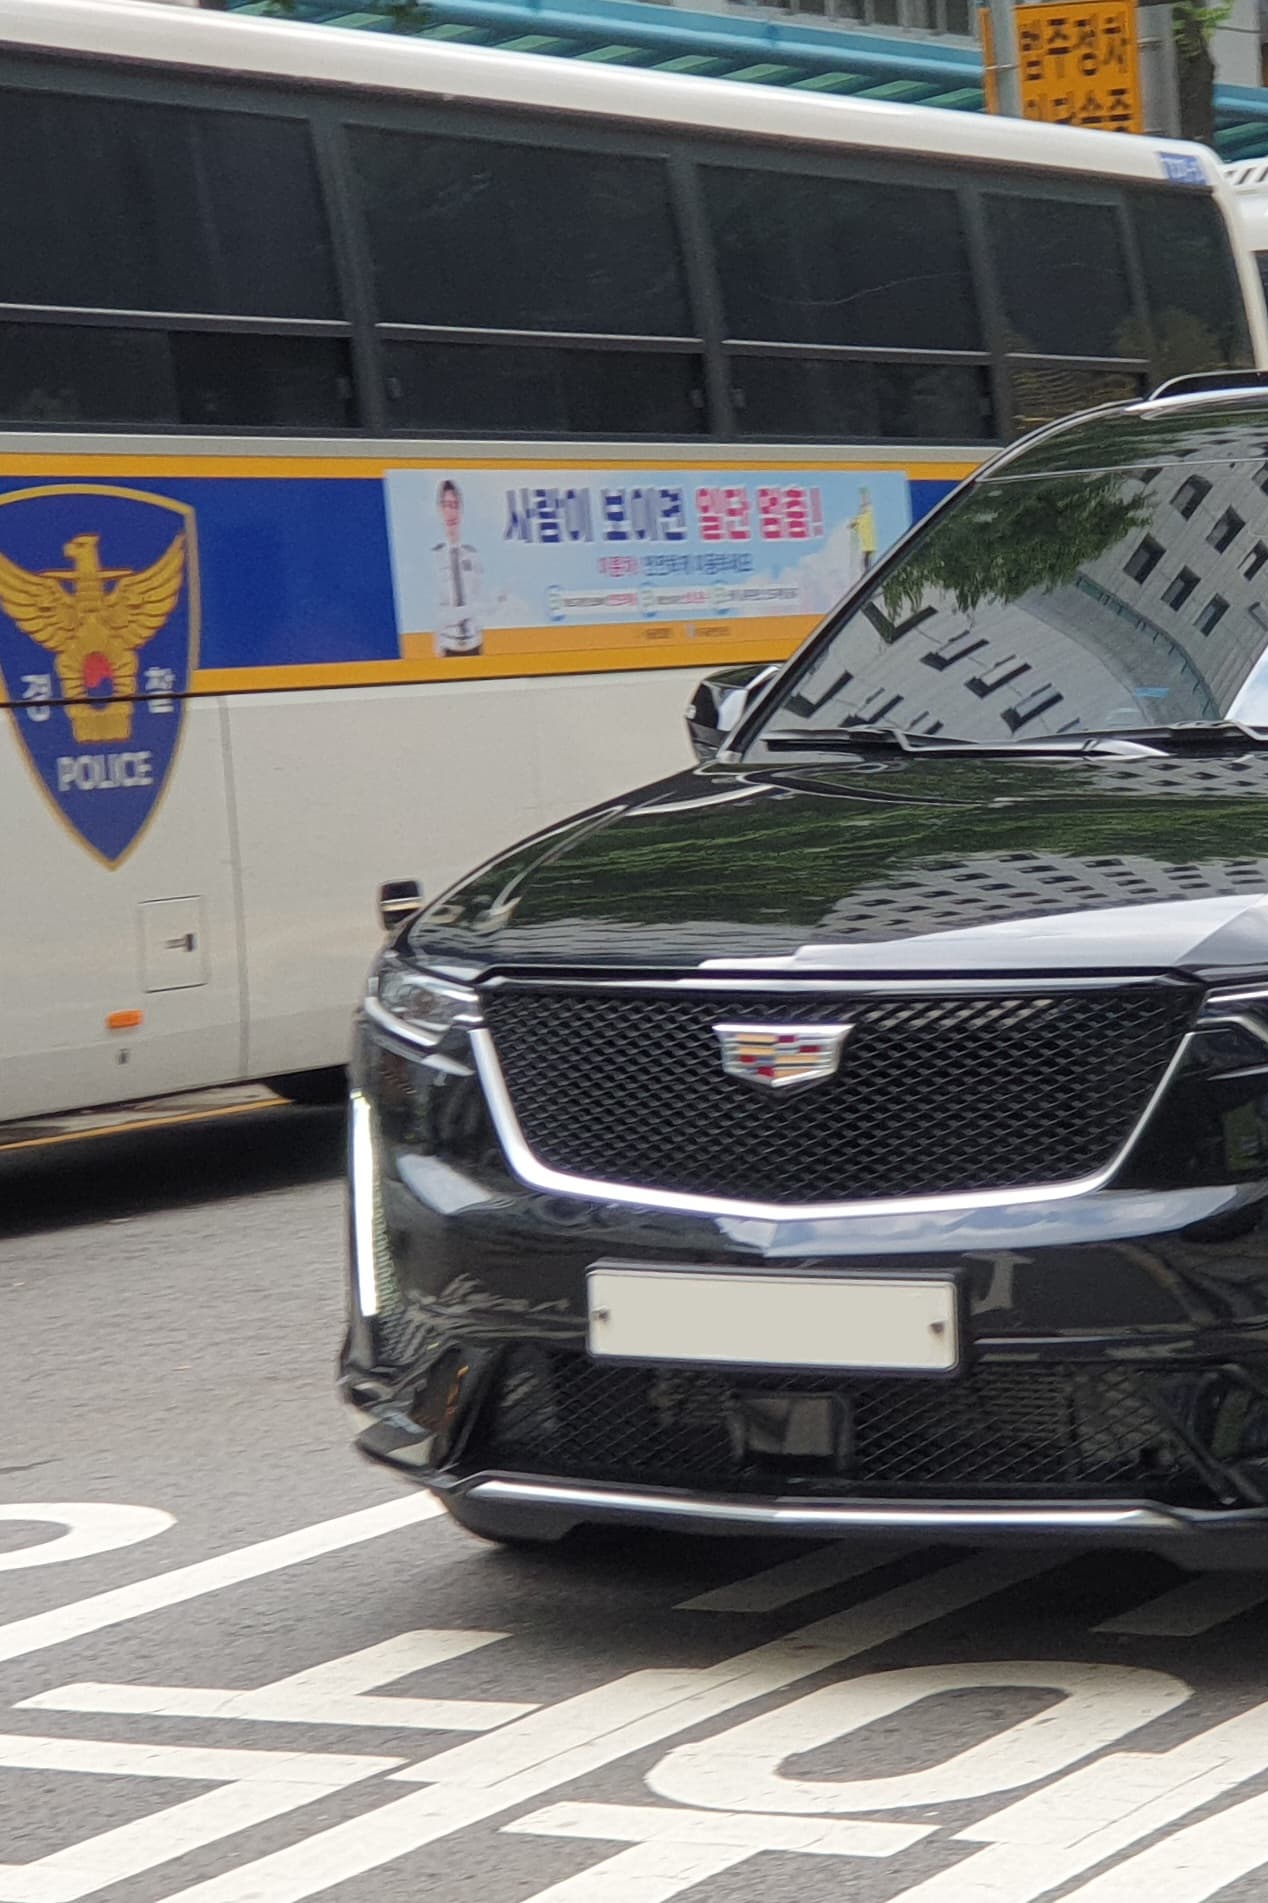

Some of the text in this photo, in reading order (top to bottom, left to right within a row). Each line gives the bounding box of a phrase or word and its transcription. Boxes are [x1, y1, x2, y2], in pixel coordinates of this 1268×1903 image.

[504, 487, 594, 543] 사람이
[600, 486, 688, 542] 보이면
[696, 486, 751, 540] 일단
[57, 751, 153, 791] POLICE
